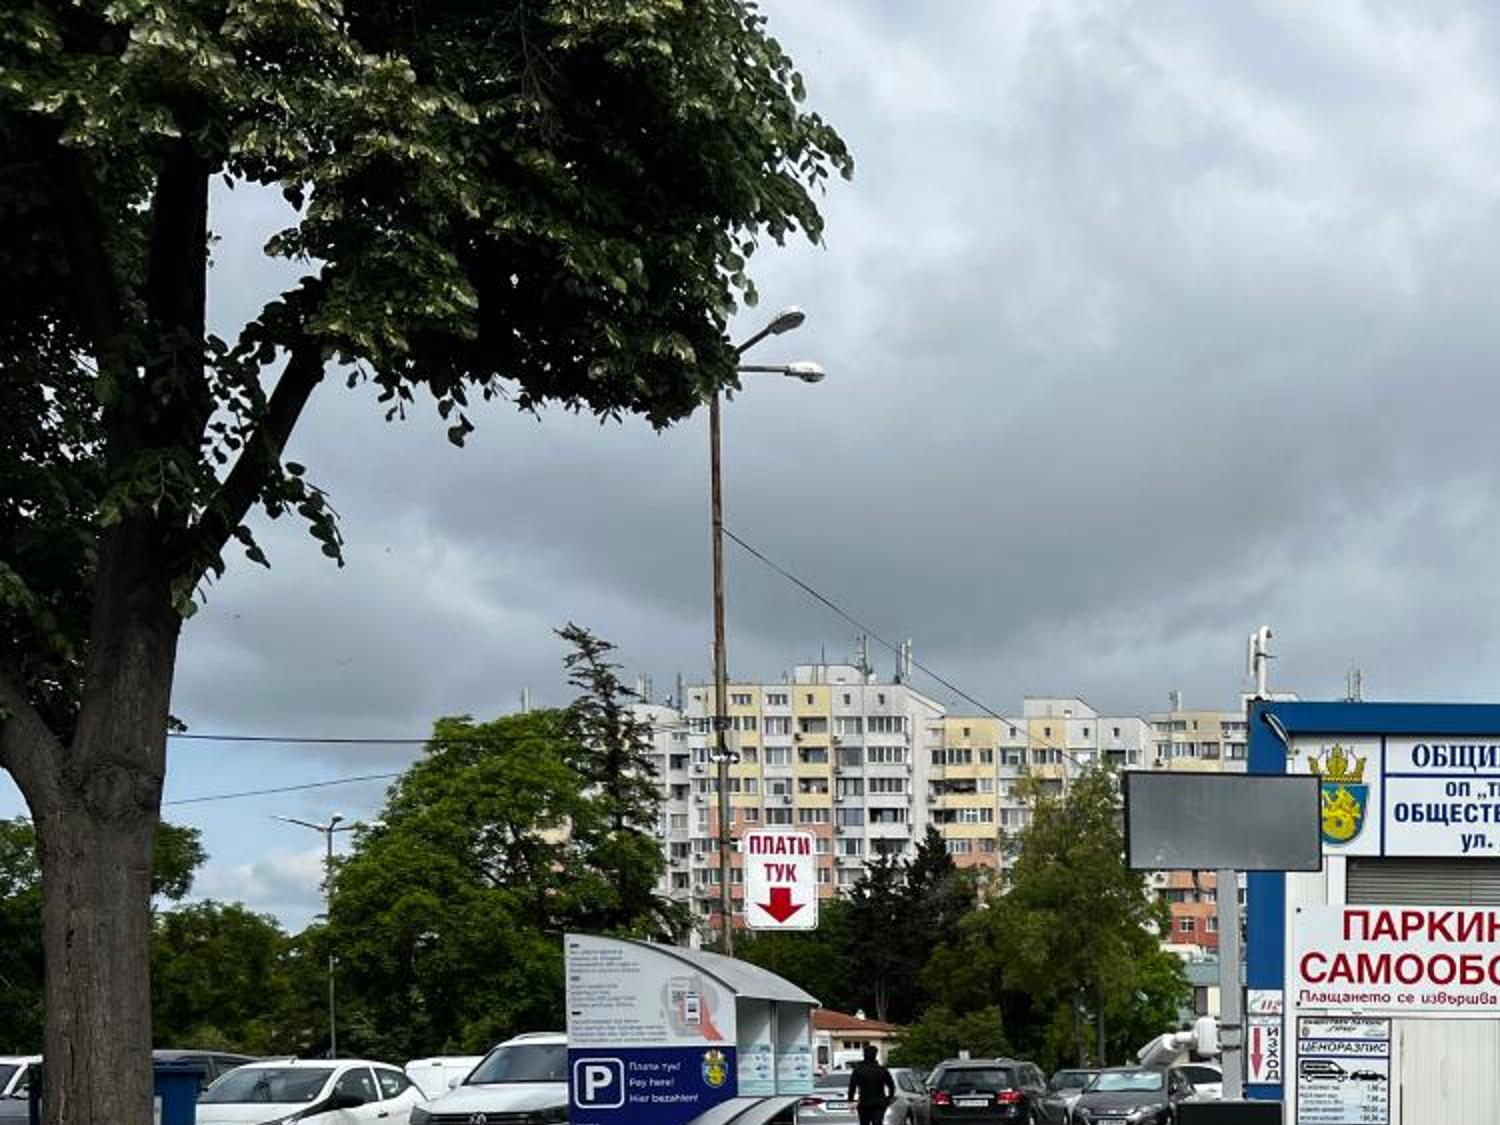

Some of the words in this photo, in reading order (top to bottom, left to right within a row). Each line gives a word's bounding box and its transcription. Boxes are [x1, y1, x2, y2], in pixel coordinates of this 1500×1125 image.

[1445, 781, 1470, 798] ОП
[749, 835, 810, 856] ПЛАТИ
[1461, 832, 1493, 852] ул.
[763, 863, 797, 883] ТУК
[1300, 990, 1391, 1004] Плащането
[1397, 993, 1415, 1004] се
[1421, 992, 1498, 1007] извършва
[1266, 1027, 1279, 1081] ИЗХОД
[1301, 1043, 1387, 1053] ЦЕНОРАЗПИС
[585, 1065, 613, 1101] P
[629, 1079, 646, 1088] Pay
